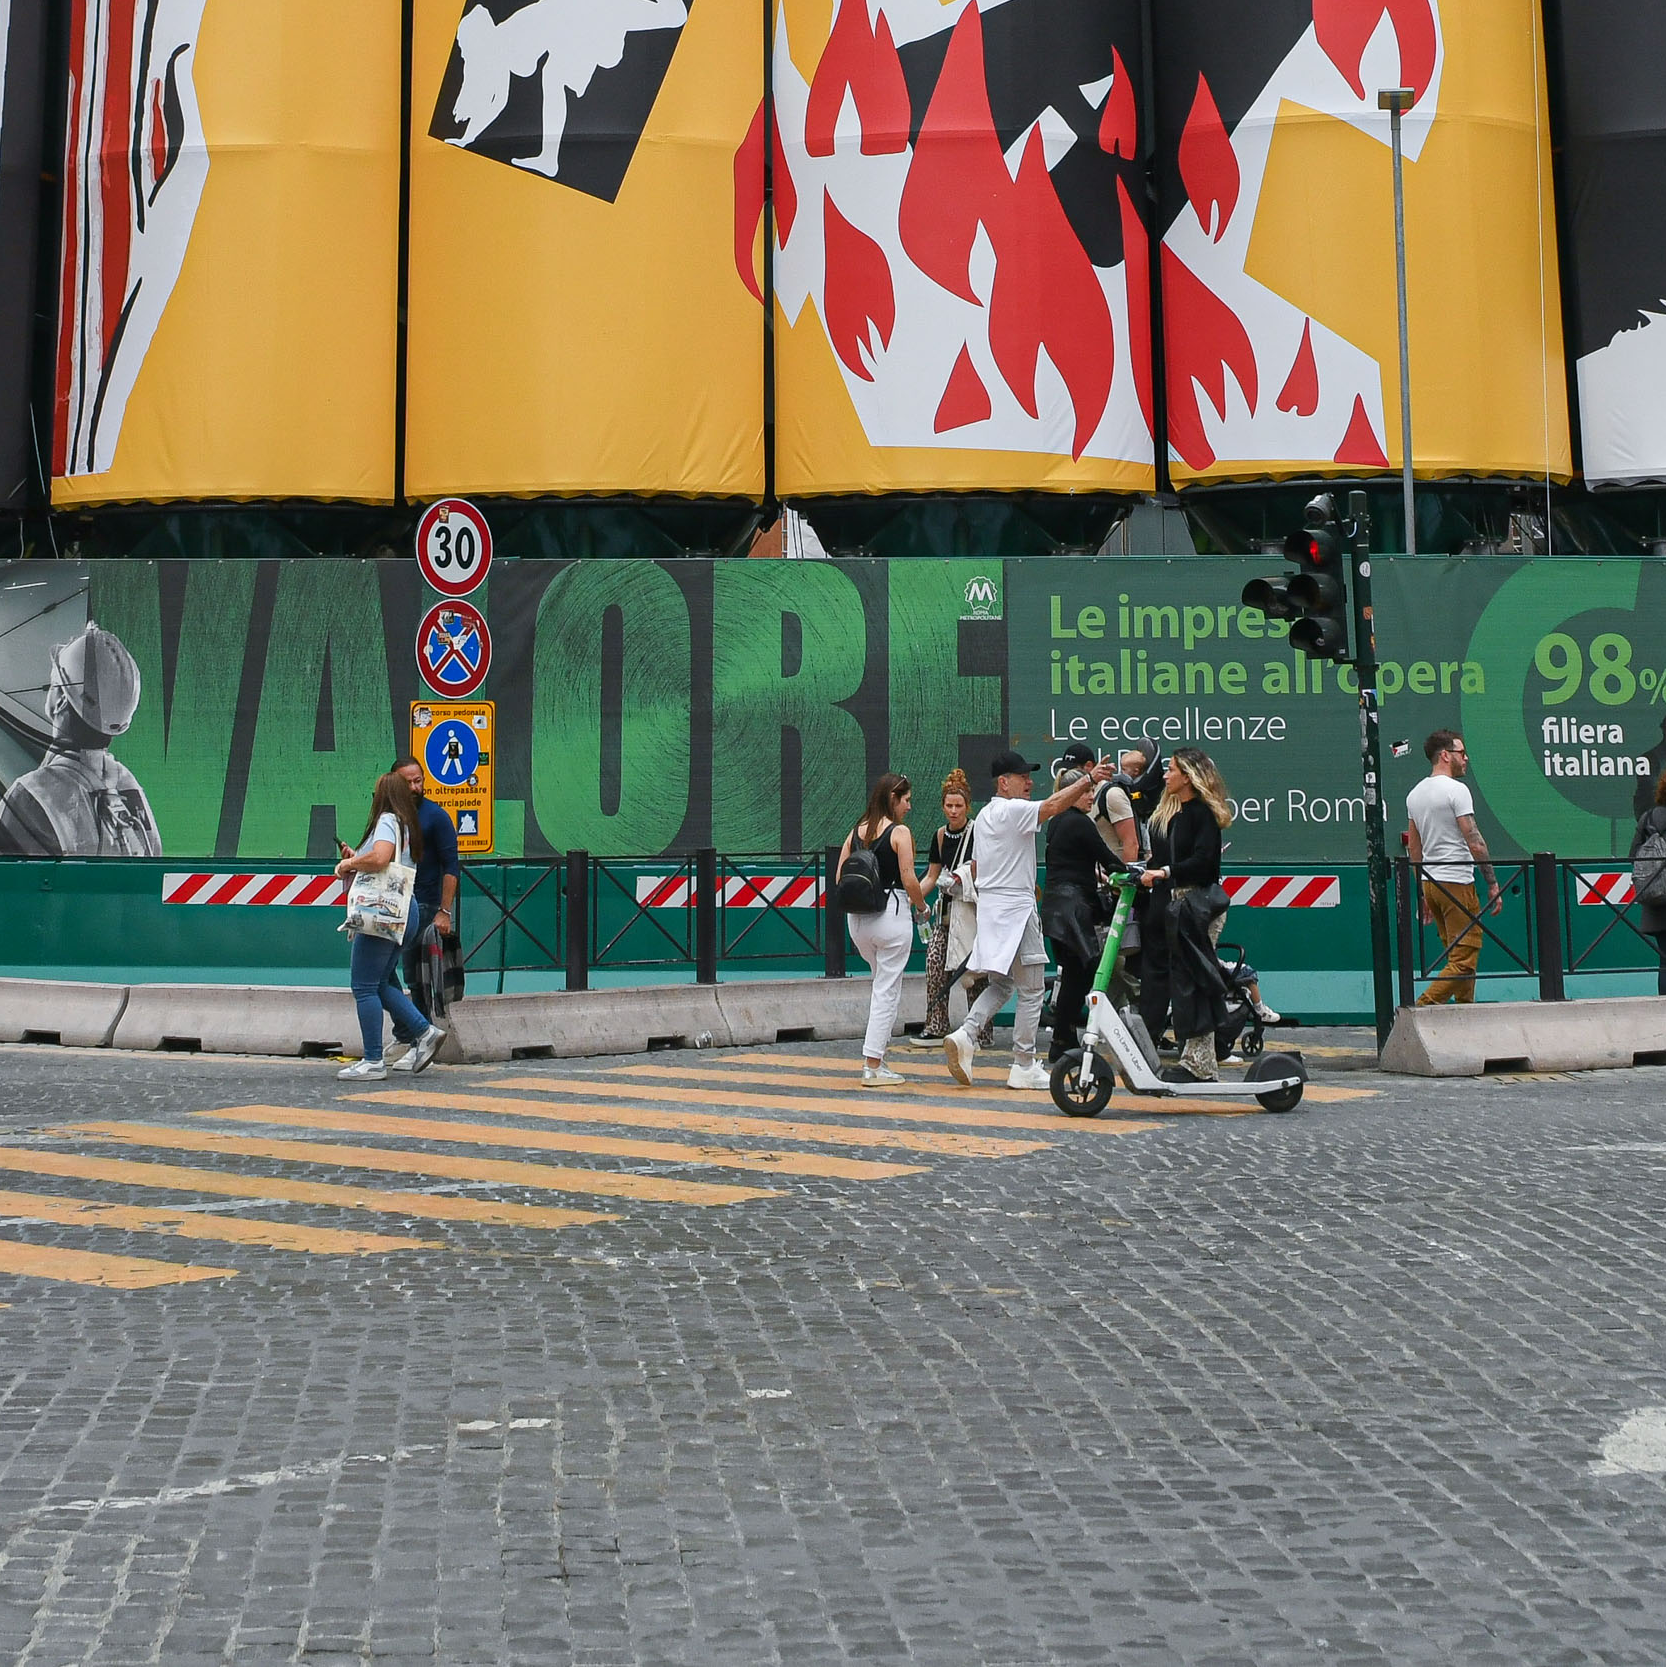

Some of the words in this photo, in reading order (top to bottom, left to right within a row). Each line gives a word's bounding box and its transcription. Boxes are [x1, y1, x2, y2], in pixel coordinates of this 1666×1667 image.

[435, 526, 475, 570] 30
[1051, 595, 1106, 638] Le
[1119, 593, 1304, 650] impres
[1051, 648, 1247, 694] italiane
[87, 559, 1006, 857] VAORE
[453, 709, 486, 718] pedonale
[1050, 708, 1089, 741] Le
[1100, 706, 1286, 741] eccellenze
[1542, 716, 1624, 744] filiera
[1543, 749, 1651, 776] italiana
[435, 786, 487, 796] oltrepassare
